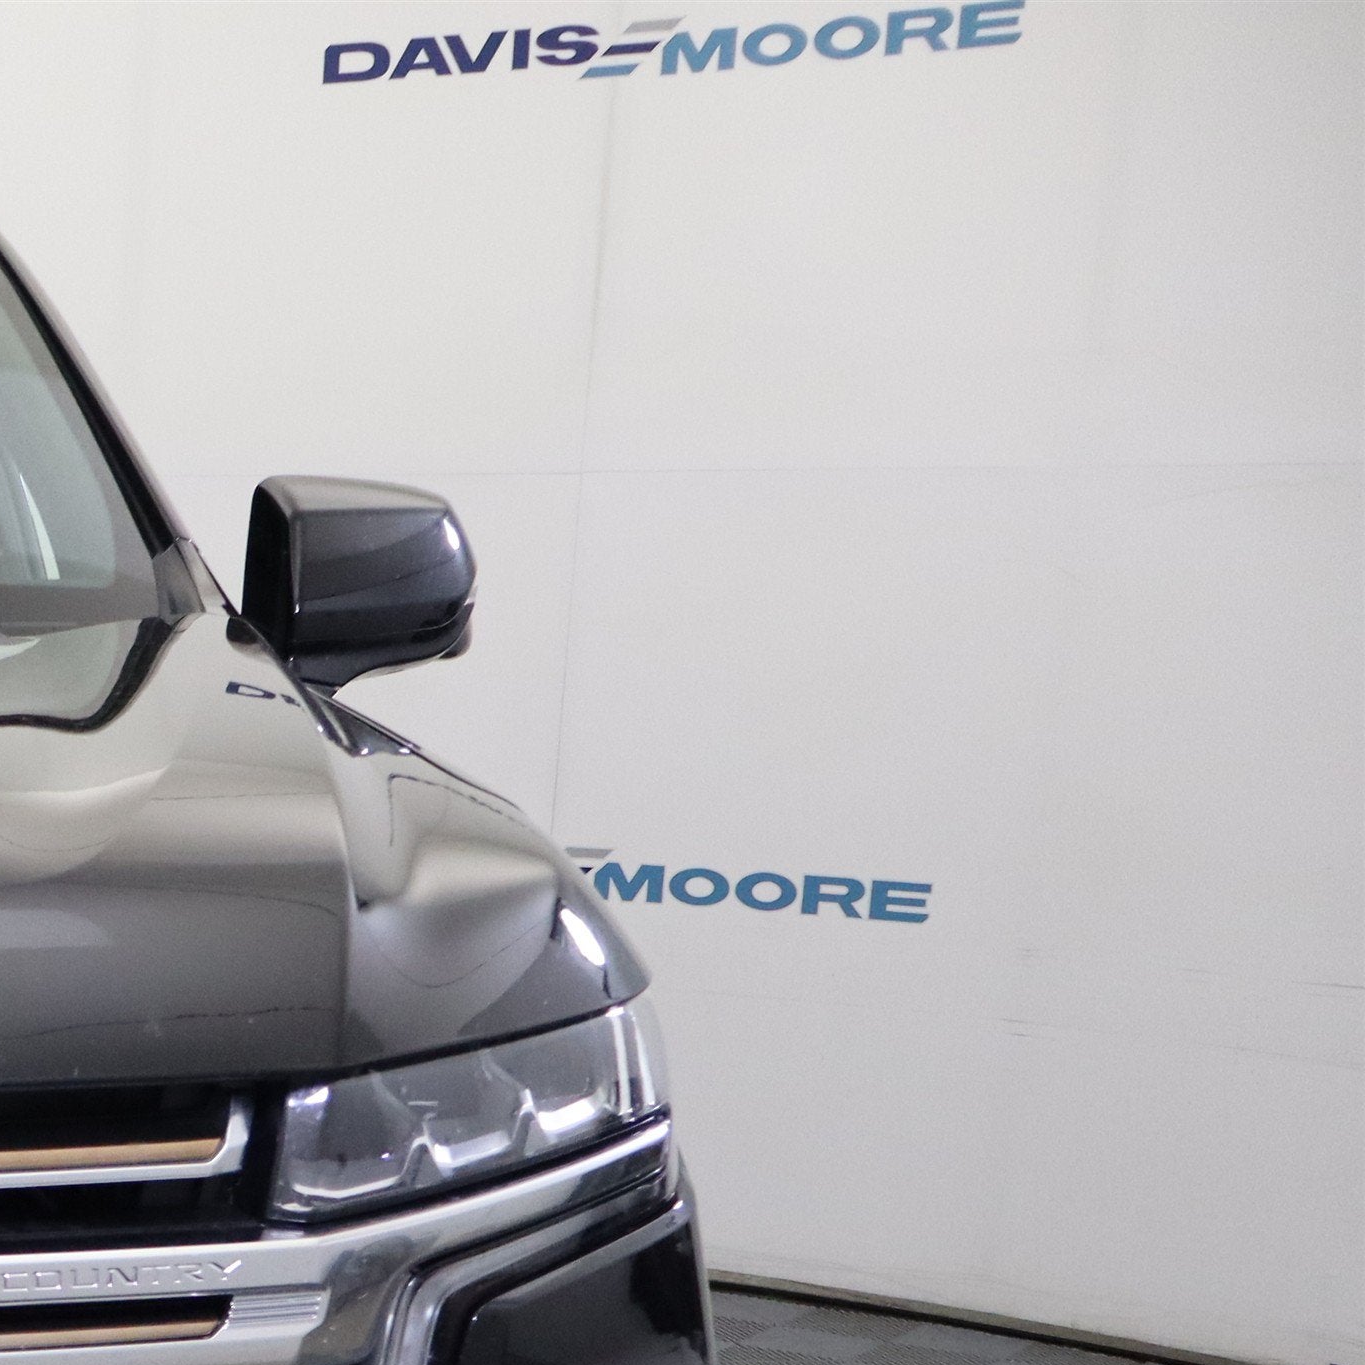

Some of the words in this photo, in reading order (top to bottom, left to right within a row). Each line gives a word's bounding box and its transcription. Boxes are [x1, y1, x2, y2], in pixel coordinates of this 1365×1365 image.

[322, 24, 599, 84] DAVIS
[660, 0, 1025, 76] MOORE
[593, 861, 932, 924] MOORE
[2, 1259, 242, 1292] COUNTRY
